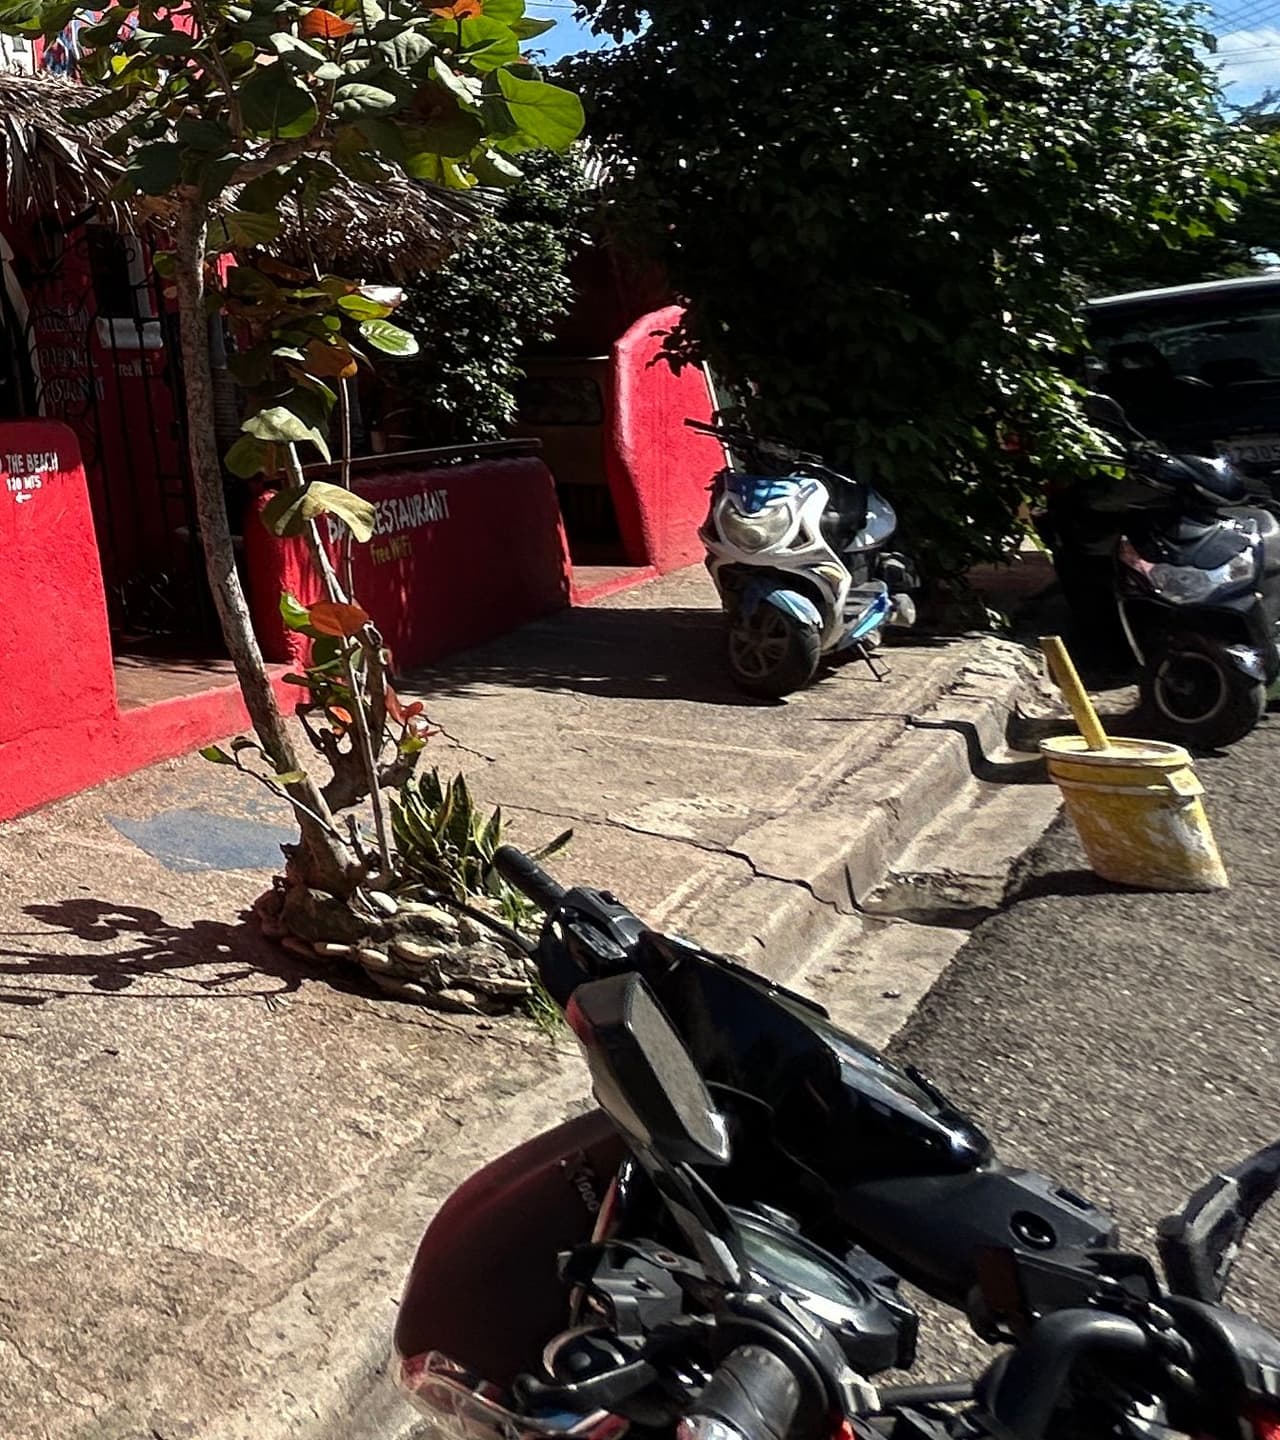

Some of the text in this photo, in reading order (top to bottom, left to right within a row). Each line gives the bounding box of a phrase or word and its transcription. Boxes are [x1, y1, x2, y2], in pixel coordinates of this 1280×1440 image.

[5, 453, 26, 474] THE
[26, 451, 60, 473] BEACH
[372, 489, 451, 536] ESTAURANT
